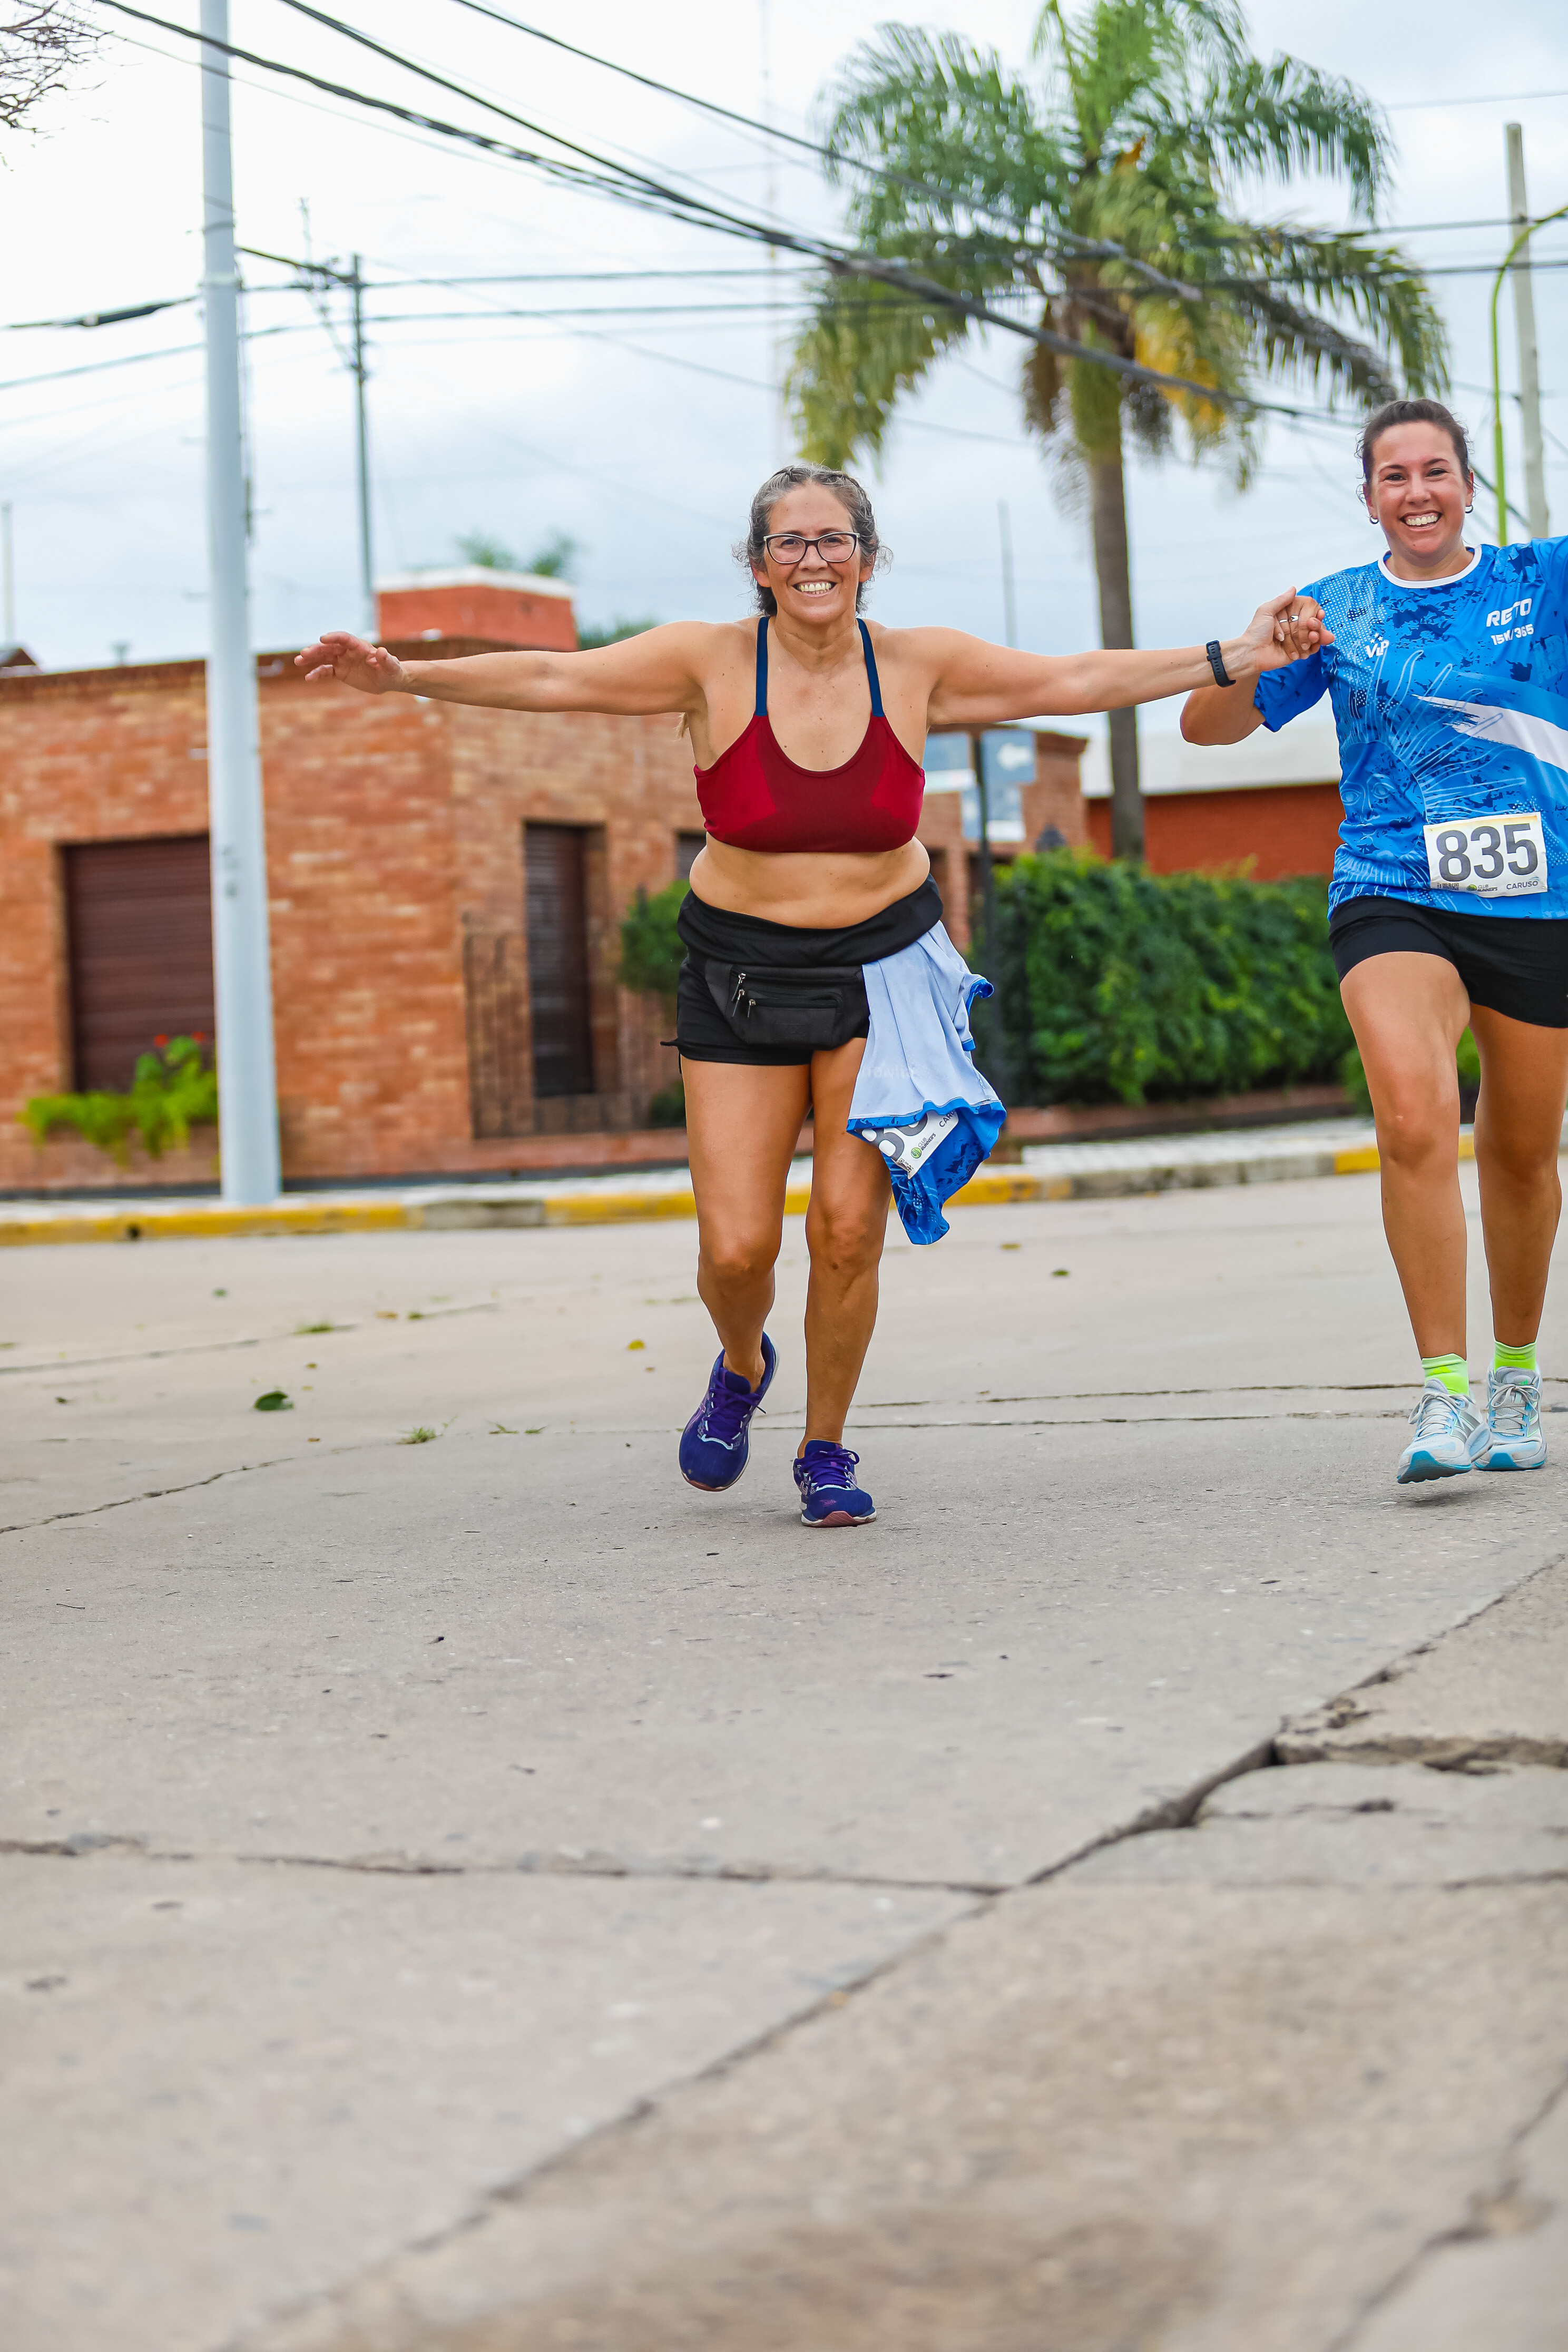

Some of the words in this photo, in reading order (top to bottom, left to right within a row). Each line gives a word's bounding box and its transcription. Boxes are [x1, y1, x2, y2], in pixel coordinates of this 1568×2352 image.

[1486, 597, 1532, 627] RETO
[1436, 824, 1538, 881] 835
[1506, 880, 1538, 890] CARUSO
[939, 1109, 956, 1128] CARU
[918, 1137, 927, 1148] CLUB
[920, 1132, 936, 1151] RUNNER'S
